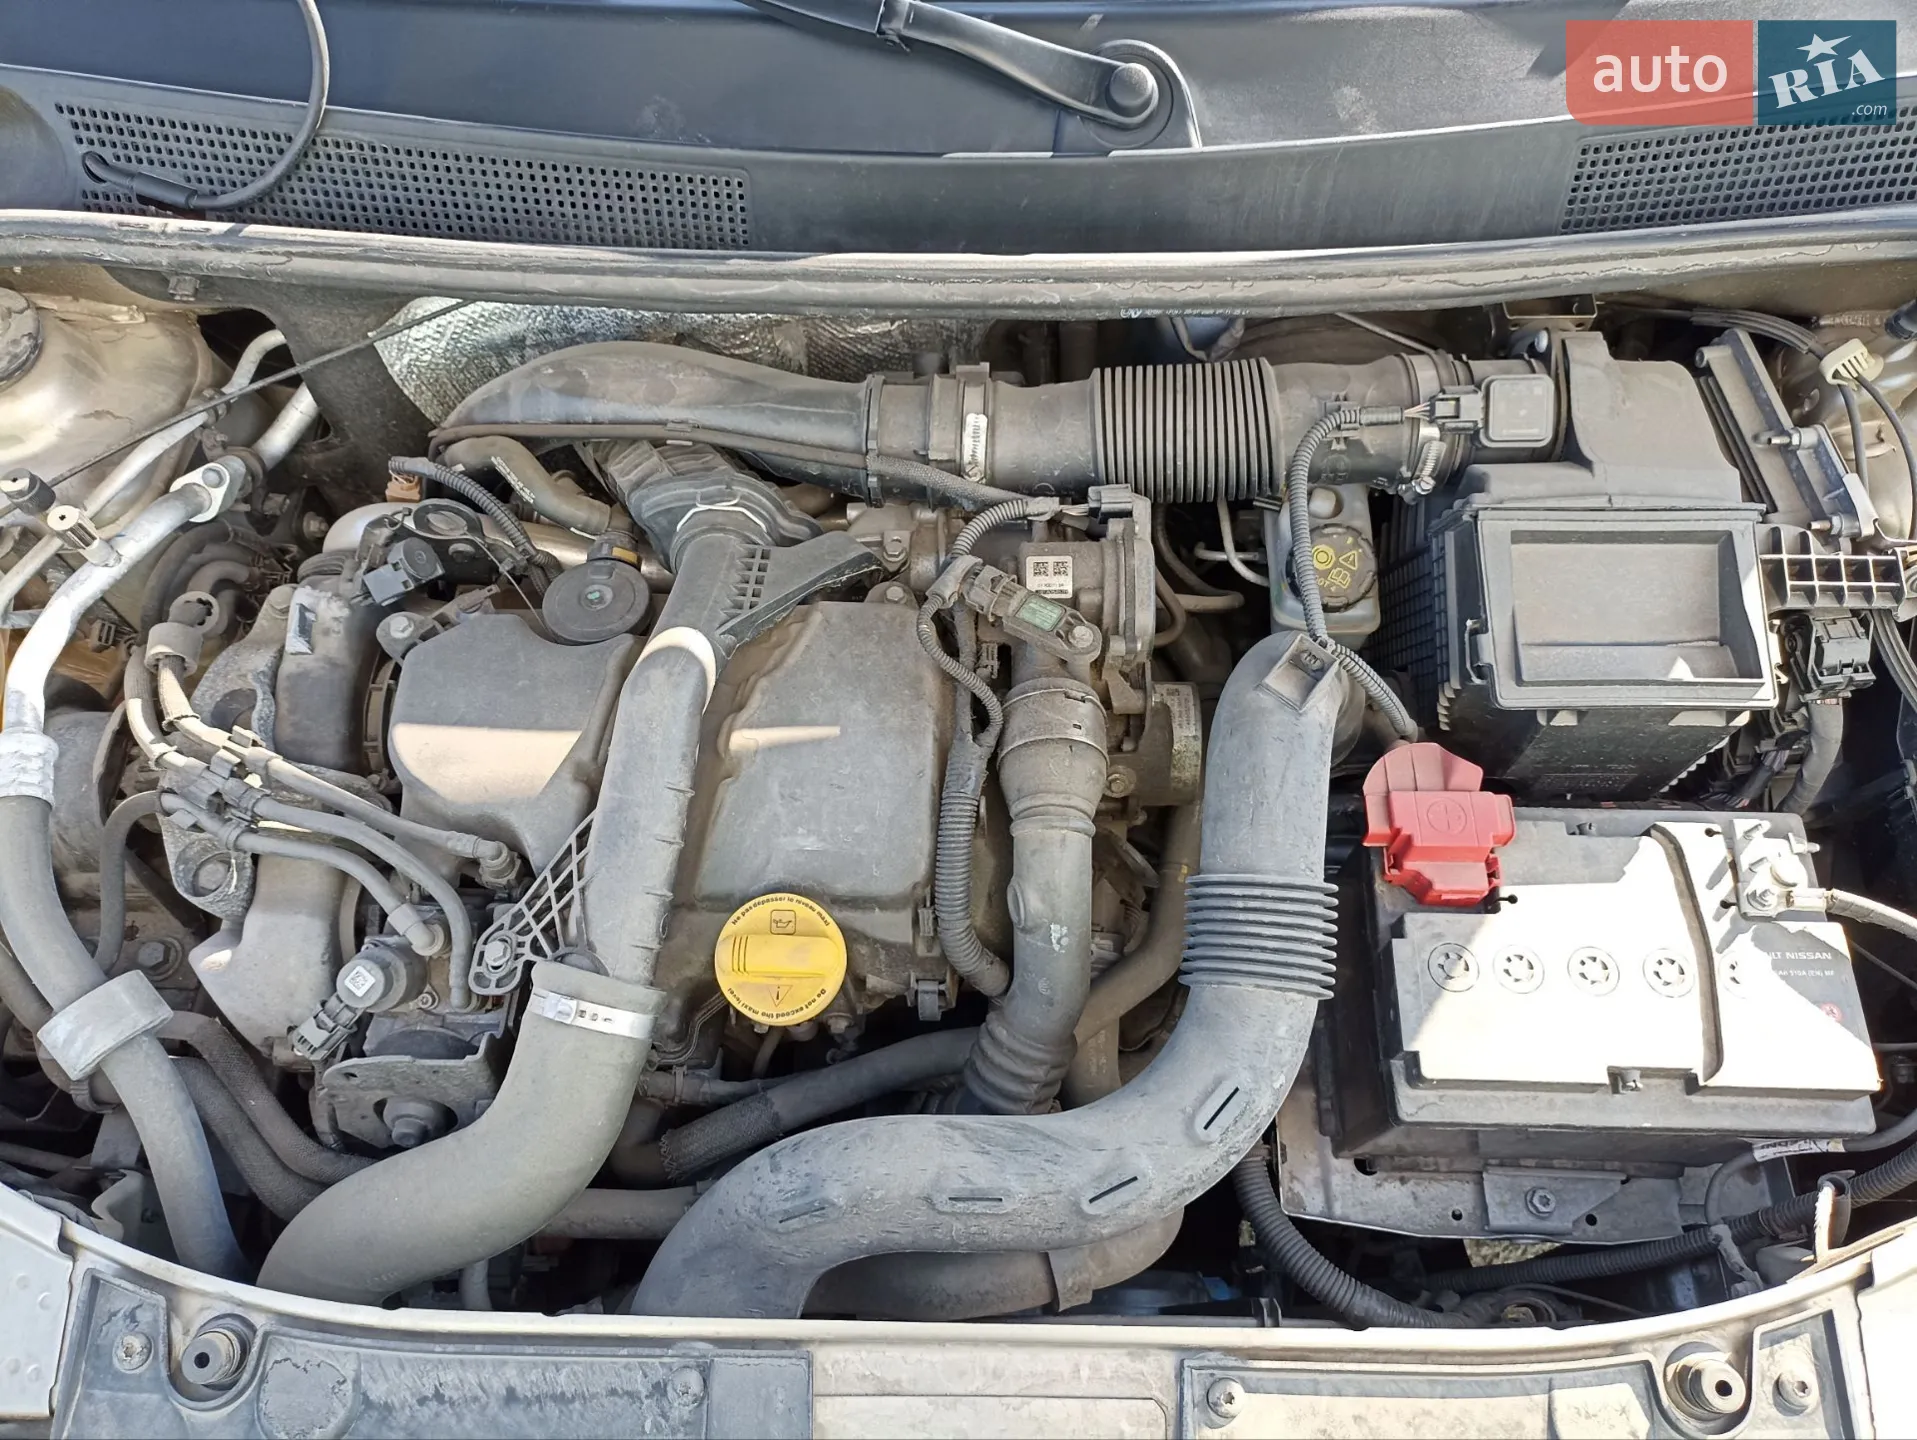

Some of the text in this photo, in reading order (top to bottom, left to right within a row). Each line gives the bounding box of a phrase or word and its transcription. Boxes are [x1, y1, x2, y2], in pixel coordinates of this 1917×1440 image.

[731, 915, 741, 926] Ne
[740, 905, 753, 917] pas
[795, 899, 817, 912] niveau
[816, 911, 831, 927] maxi
[1785, 951, 1833, 960] NISSAN
[727, 987, 827, 1019] Do not exceed the maxi level
